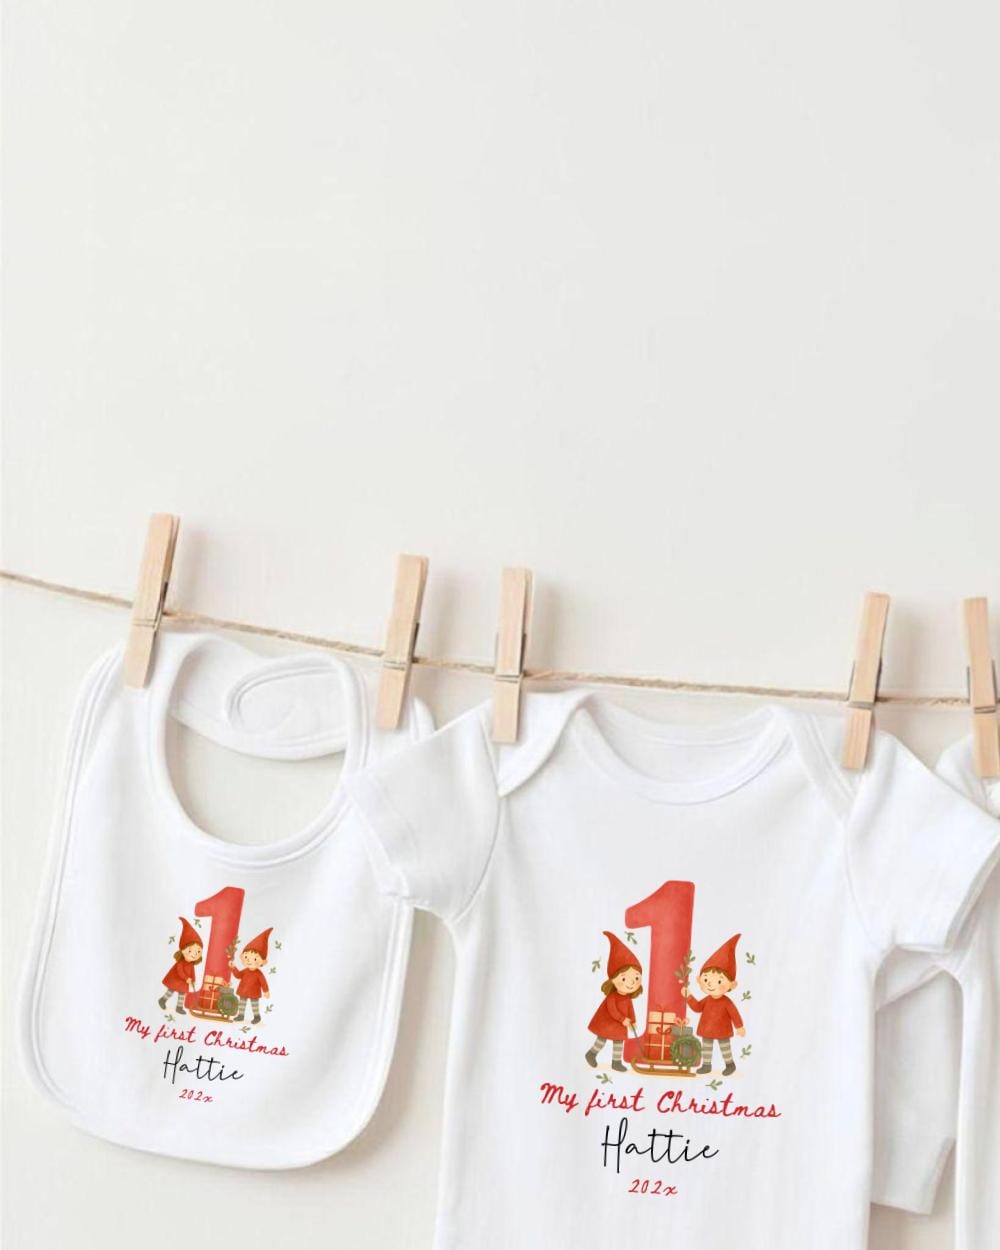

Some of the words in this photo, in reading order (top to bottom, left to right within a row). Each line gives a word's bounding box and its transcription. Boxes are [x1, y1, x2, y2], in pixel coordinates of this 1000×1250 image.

[184, 886, 245, 1015] 1
[623, 880, 701, 1066] 1
[125, 1016, 150, 1040] My
[153, 1025, 196, 1043] first
[204, 1030, 289, 1057] Christmas
[163, 1045, 244, 1085] Hattie
[179, 1089, 213, 1103] 202x
[539, 1082, 578, 1114] My
[584, 1087, 645, 1117] first
[656, 1089, 782, 1119] Christmas
[600, 1116, 720, 1174] Hattie
[628, 1179, 678, 1195] 202x
